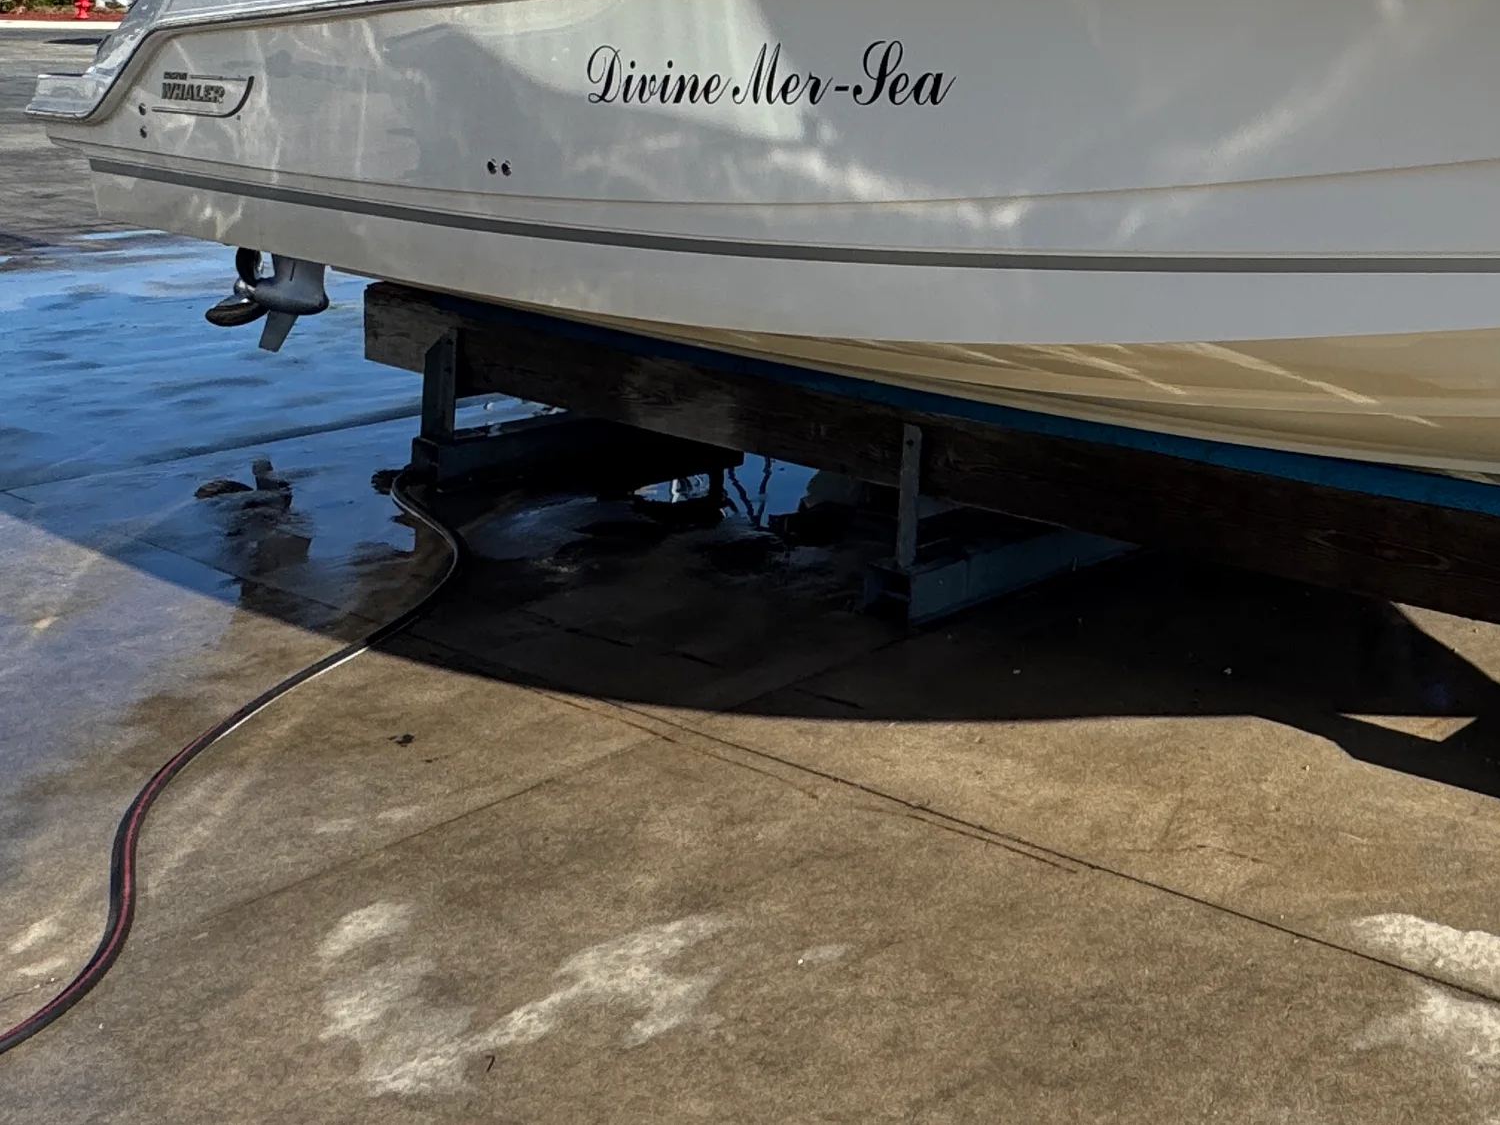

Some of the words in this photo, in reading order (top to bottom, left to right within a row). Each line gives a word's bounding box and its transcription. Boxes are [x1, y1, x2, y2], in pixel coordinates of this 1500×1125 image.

[161, 82, 226, 104] WHALER
[586, 44, 733, 104] Divine
[731, 39, 957, 106] Mer-Sea
